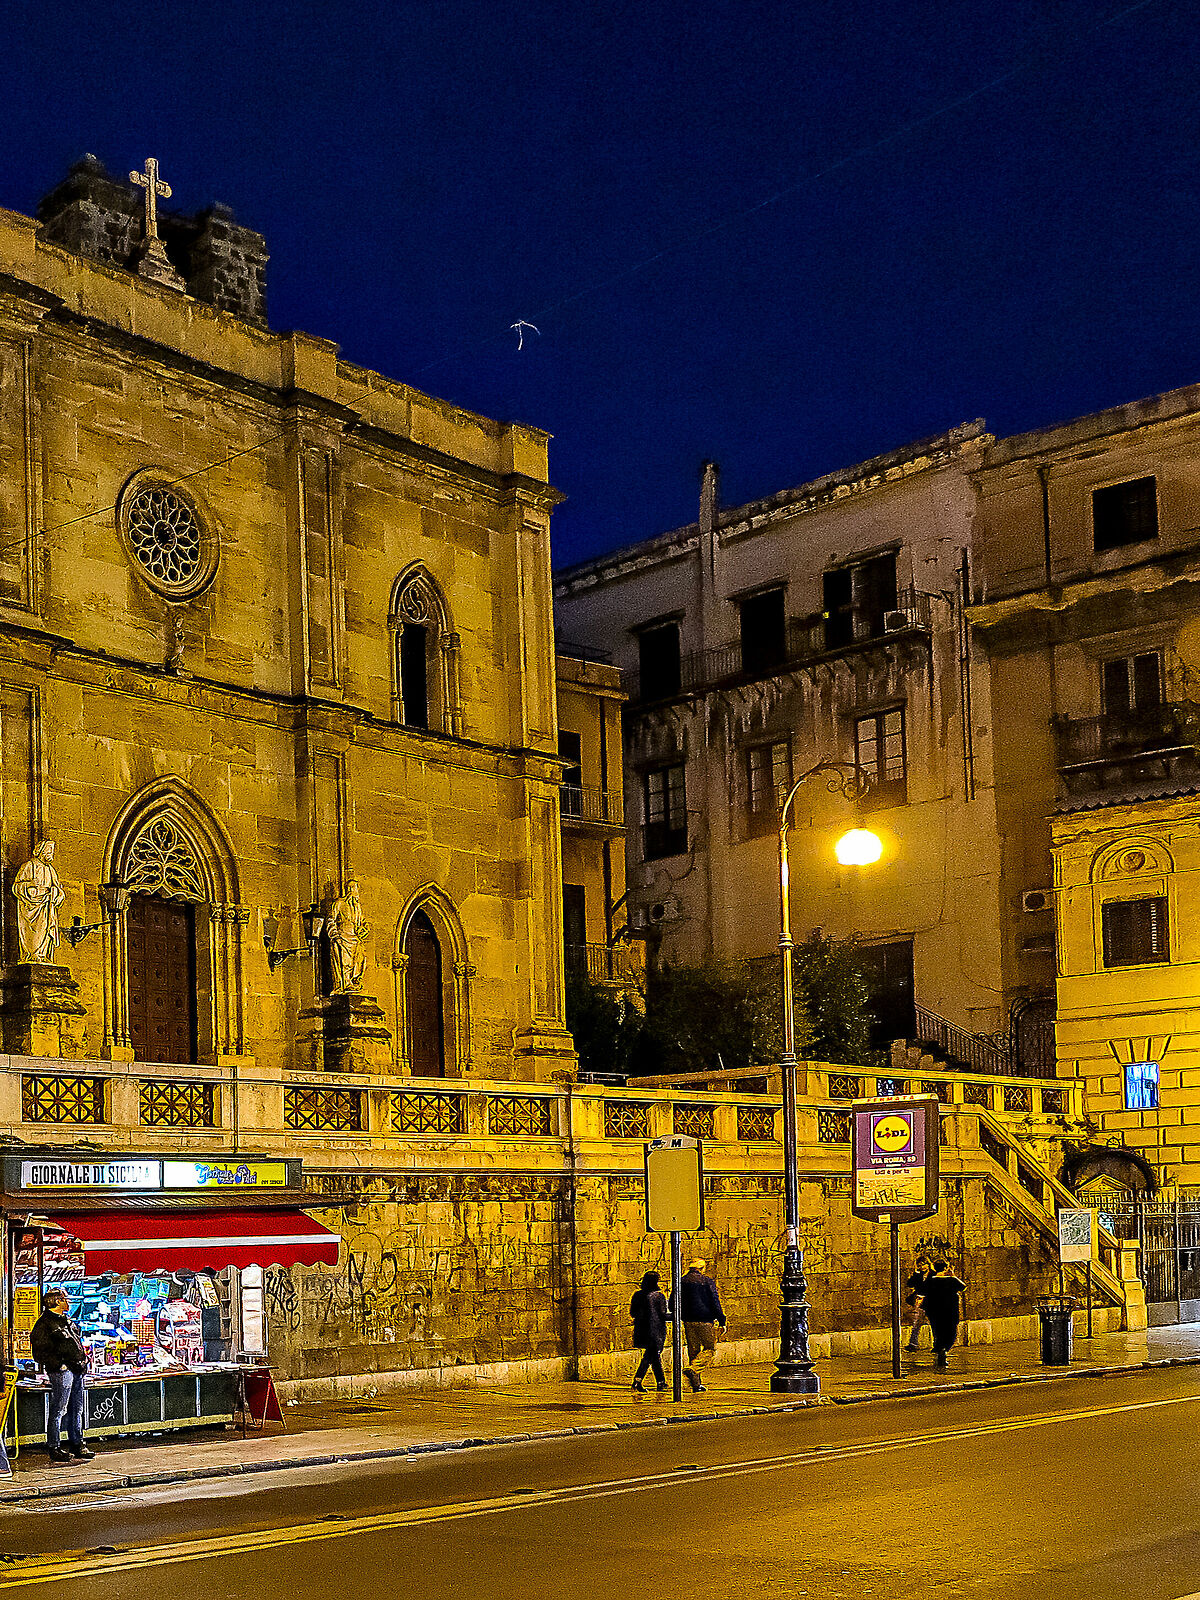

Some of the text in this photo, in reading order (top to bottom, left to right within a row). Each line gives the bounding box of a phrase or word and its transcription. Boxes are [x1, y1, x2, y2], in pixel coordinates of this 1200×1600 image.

[671, 1139, 682, 1147] M
[32, 1165, 90, 1184] GIORNALE
[93, 1165, 105, 1184] DI
